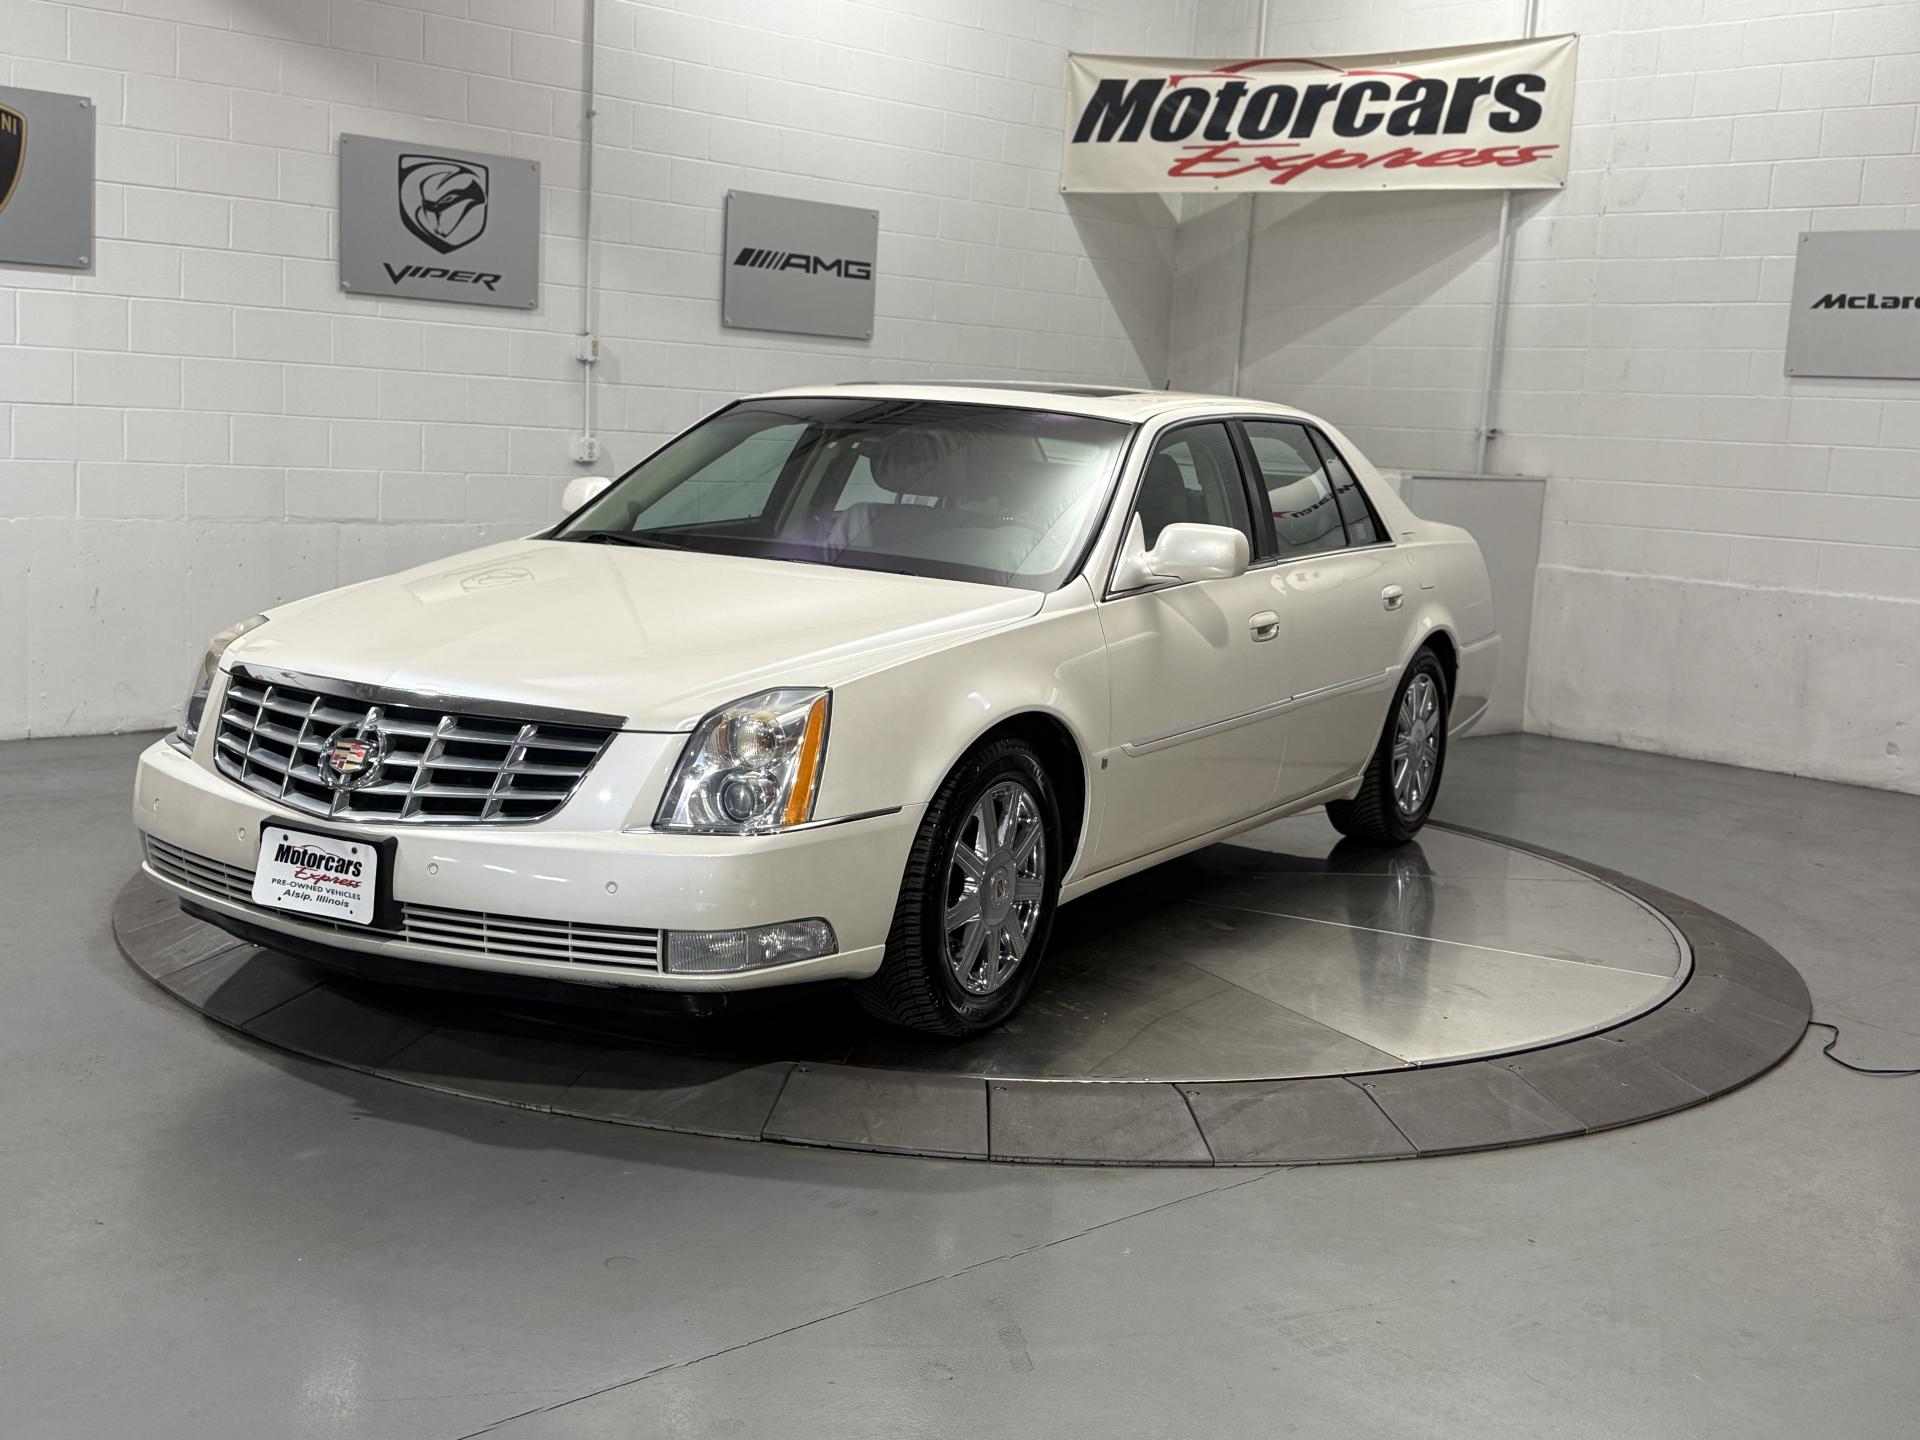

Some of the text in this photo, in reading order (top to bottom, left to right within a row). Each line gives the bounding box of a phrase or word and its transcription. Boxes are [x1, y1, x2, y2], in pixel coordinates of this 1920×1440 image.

[1071, 73, 1547, 144] Motorcars
[1167, 141, 1560, 185] Express
[382, 262, 502, 292] VIPER
[778, 253, 872, 280] AMG
[274, 844, 363, 877] Motorcars
[271, 877, 361, 901] PRE-OWNED VEHICLES
[294, 867, 363, 889] Express
[283, 889, 350, 908] Alsip, Illinois
